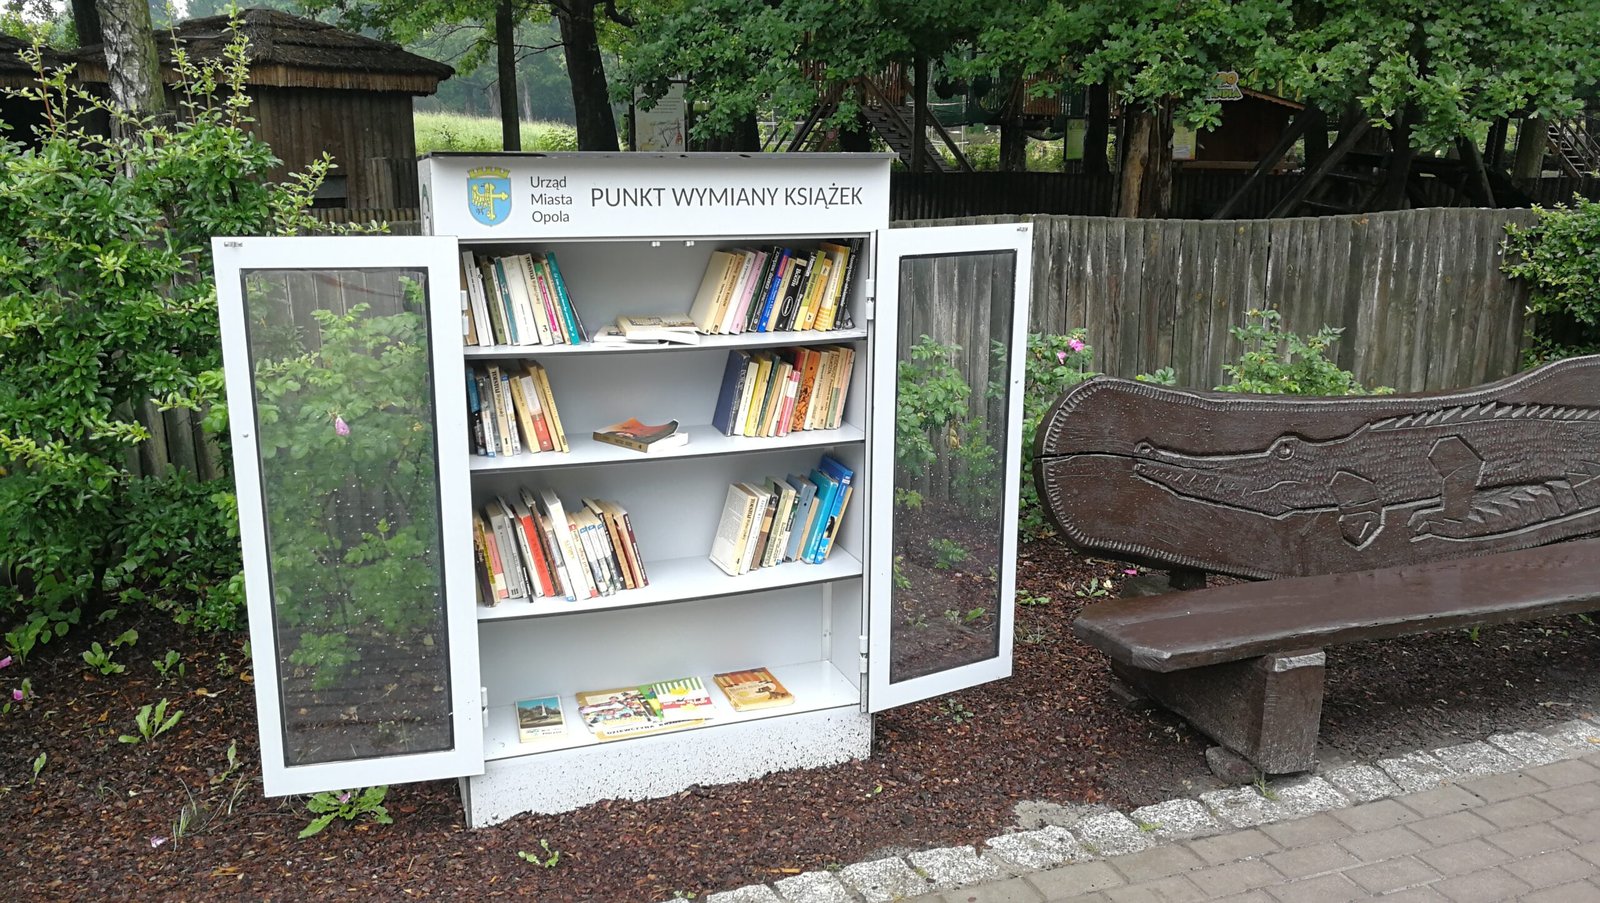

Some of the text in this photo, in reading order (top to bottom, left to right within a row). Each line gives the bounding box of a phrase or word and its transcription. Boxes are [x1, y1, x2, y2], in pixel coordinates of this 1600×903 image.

[530, 175, 567, 190] Urząd
[531, 193, 573, 205] Miasta
[592, 182, 863, 209] PUNKT WYMIANY KSIĄŻEK
[532, 210, 570, 224] Opola
